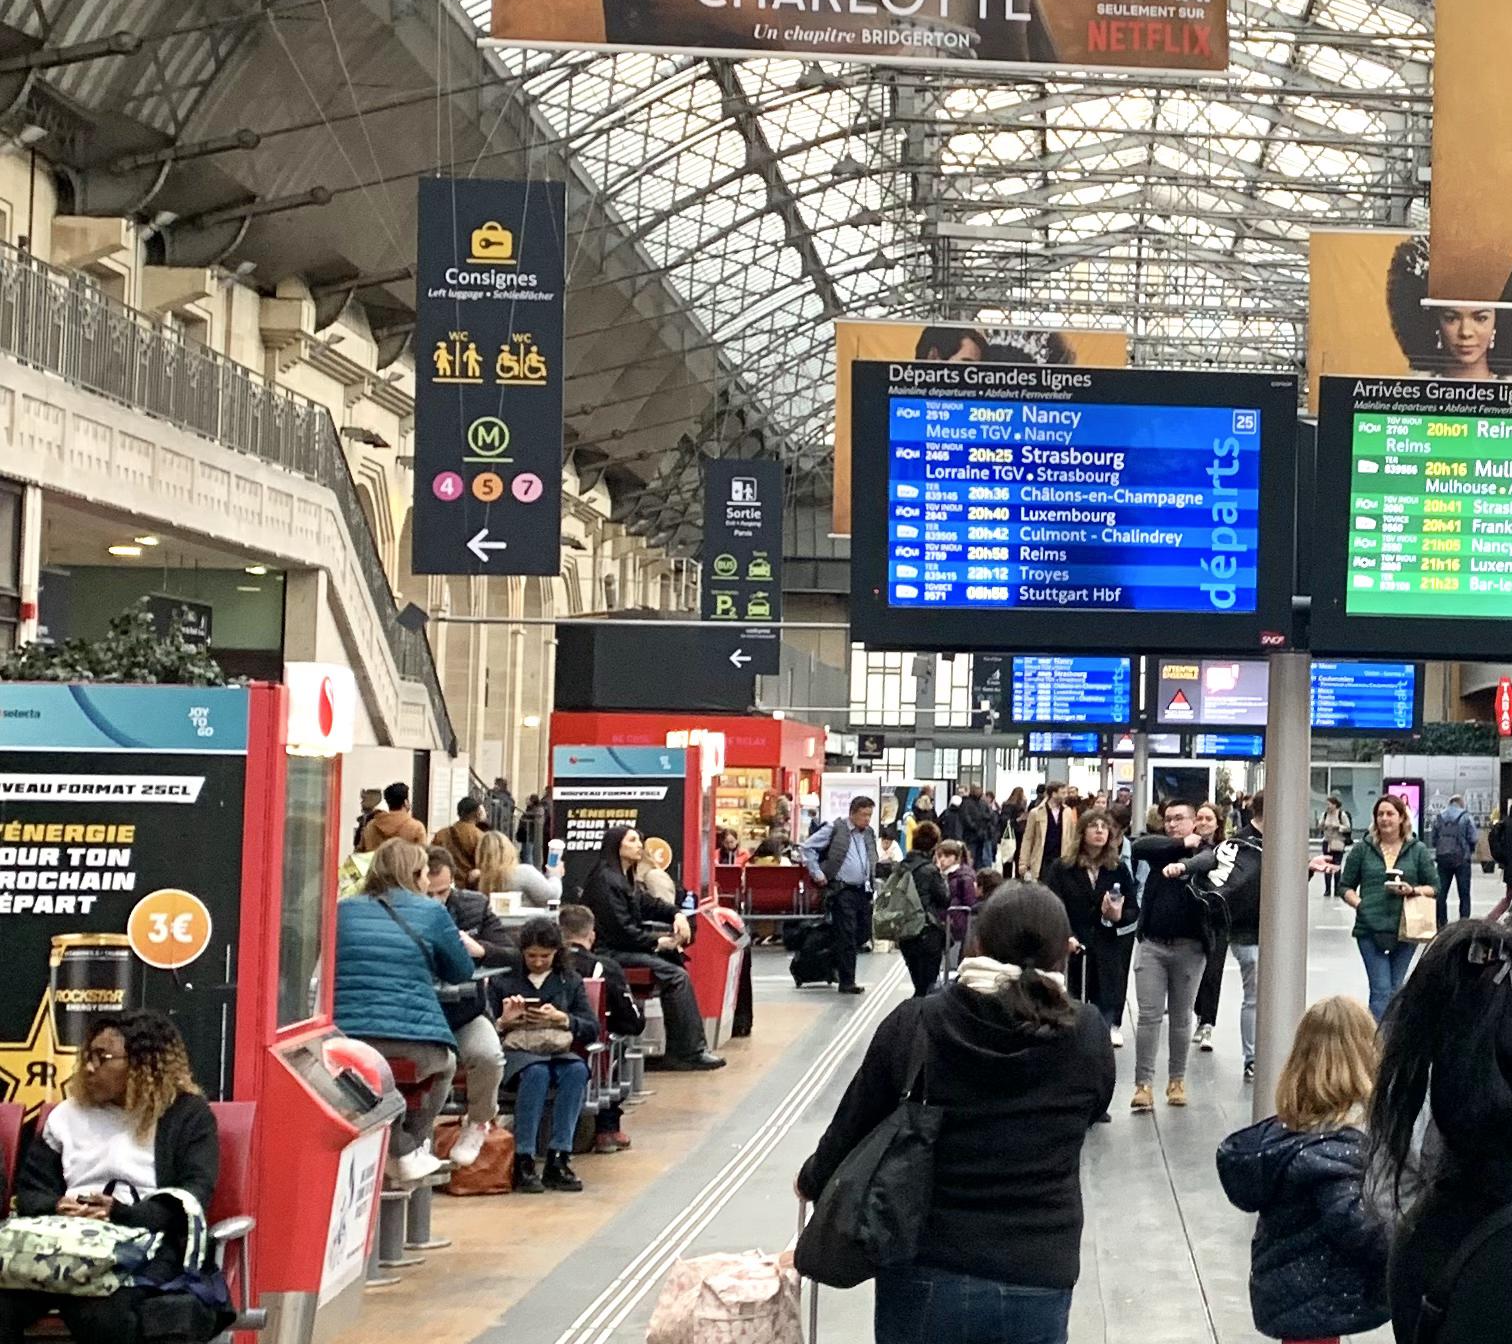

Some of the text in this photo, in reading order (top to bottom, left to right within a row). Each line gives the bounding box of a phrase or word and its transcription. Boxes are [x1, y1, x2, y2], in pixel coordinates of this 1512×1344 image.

[1097, 3, 1205, 19] SEULEMENT SUR
[753, 24, 970, 49] Un chapitre BRIDGERTON
[1088, 19, 1211, 56] NETFLIX
[445, 268, 537, 289] Consignes
[428, 288, 446, 298] Left
[449, 331, 532, 343] WC WC
[889, 365, 1091, 390] Départs Grandes lignes
[1353, 380, 1420, 398] Arrivées
[1426, 383, 1494, 400] Grandes
[969, 406, 1254, 428] 20h07 Nancy 25
[926, 424, 1072, 445] Meuse TGV Nancy
[1427, 423, 1468, 437] 20h01
[1386, 438, 1431, 453] Reims
[968, 446, 1125, 470] 20h25 Strasbourg
[926, 465, 1119, 486] Lorraine TGV Strasbourg
[1425, 462, 1467, 477] 20h16
[440, 478, 533, 495] 4 5 7
[1426, 479, 1496, 494] Mulhouse
[1020, 487, 1203, 508] Châlons-en-Champagne
[726, 508, 761, 519] Sortie
[1423, 499, 1462, 513] 20h41
[1020, 507, 1116, 524] Luxembourg
[1200, 437, 1247, 609] départs
[1422, 519, 1461, 532] 20h41
[1020, 527, 1183, 547] Culmont Chalindrey
[1020, 547, 1067, 561] Reims
[719, 561, 733, 570] BUS
[1020, 567, 1069, 583] Troyes
[1020, 586, 1122, 603] Stuttgart Hbf
[3, 709, 40, 719] selecta
[188, 707, 209, 718] JOY
[192, 718, 207, 727] TO
[197, 727, 213, 737] GO
[0, 783, 191, 795] VEAU FORMAT 25CL
[567, 809, 638, 818] L'ÉNERGIE
[0, 820, 135, 843] 'ÉNERGIE
[567, 820, 605, 829] POUR
[0, 848, 131, 867] OUR TON
[0, 872, 135, 891] ROCHAIN
[0, 891, 97, 914] ÉPART
[148, 912, 193, 944] 3€
[55, 990, 125, 1002] ROCKSTAR
